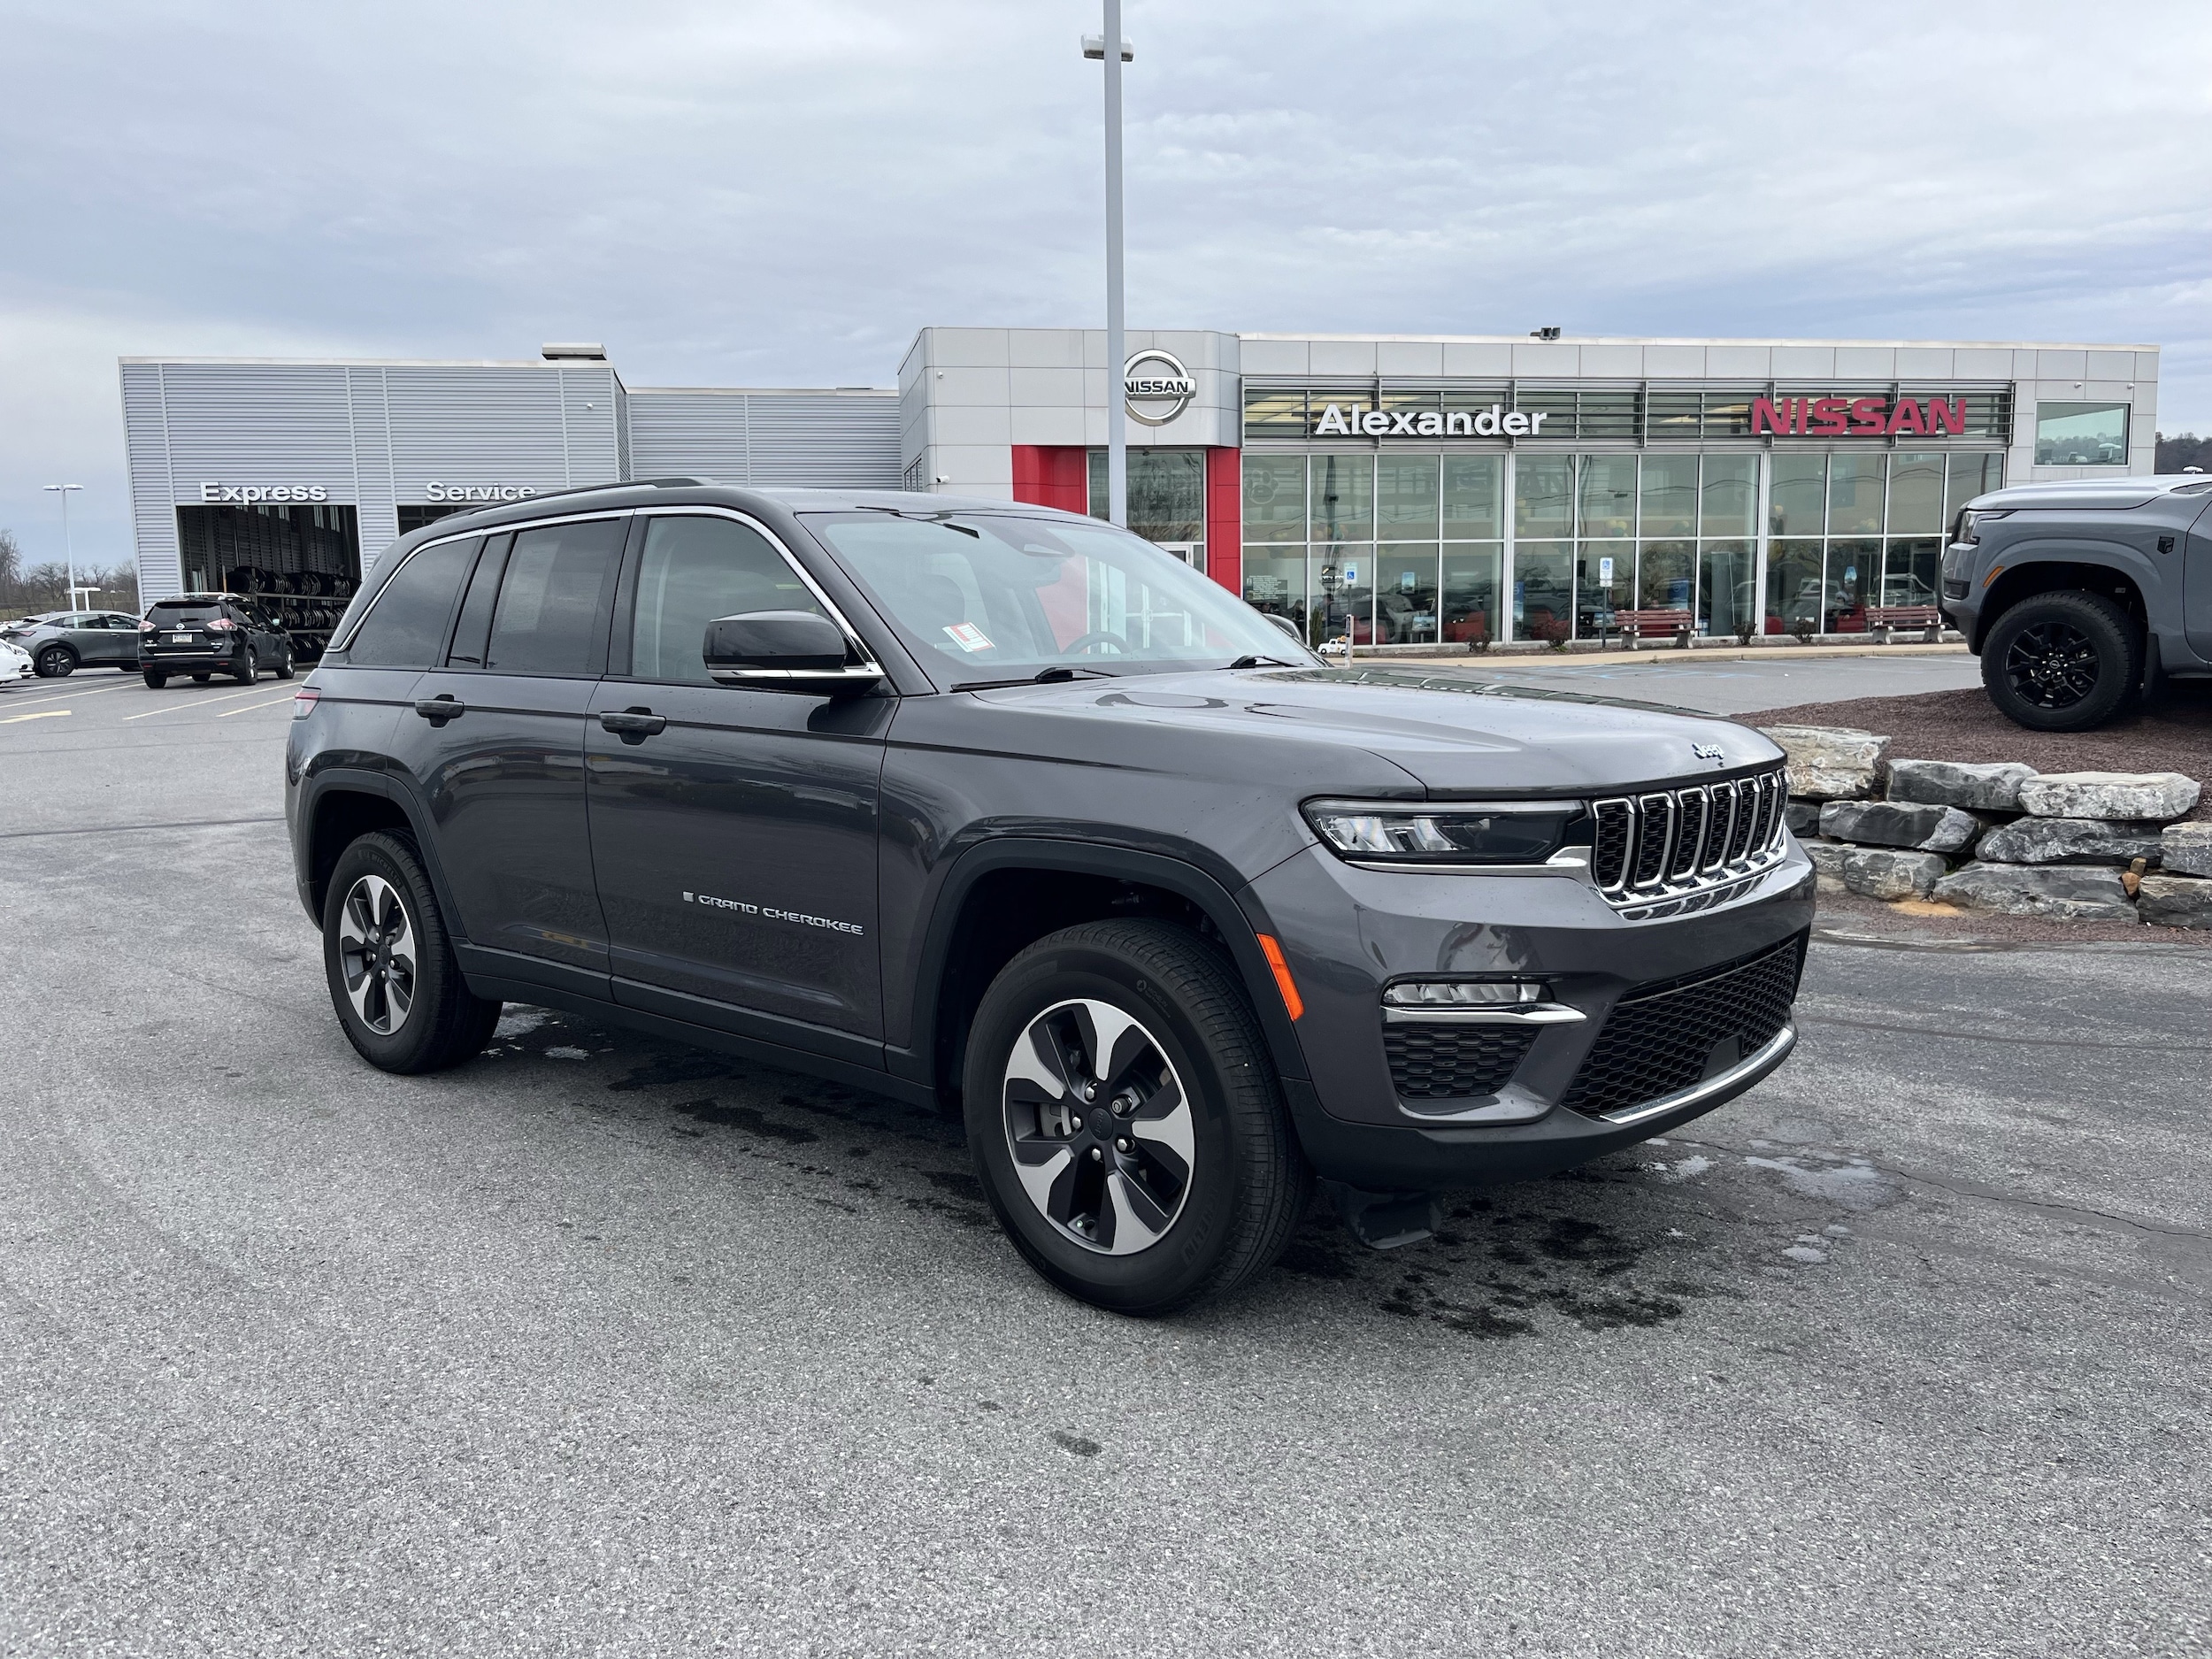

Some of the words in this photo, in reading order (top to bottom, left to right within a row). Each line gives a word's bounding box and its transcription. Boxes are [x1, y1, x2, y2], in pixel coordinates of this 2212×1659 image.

[1125, 380, 1188, 393] NISSAN
[1315, 403, 1548, 436] Alexander
[1751, 398, 1966, 434] NISSAN
[200, 481, 327, 505] Express
[426, 481, 536, 502] Service
[1692, 742, 1725, 759] Jeep
[698, 895, 758, 915] GRAND
[762, 907, 864, 936] CHEROKEE
